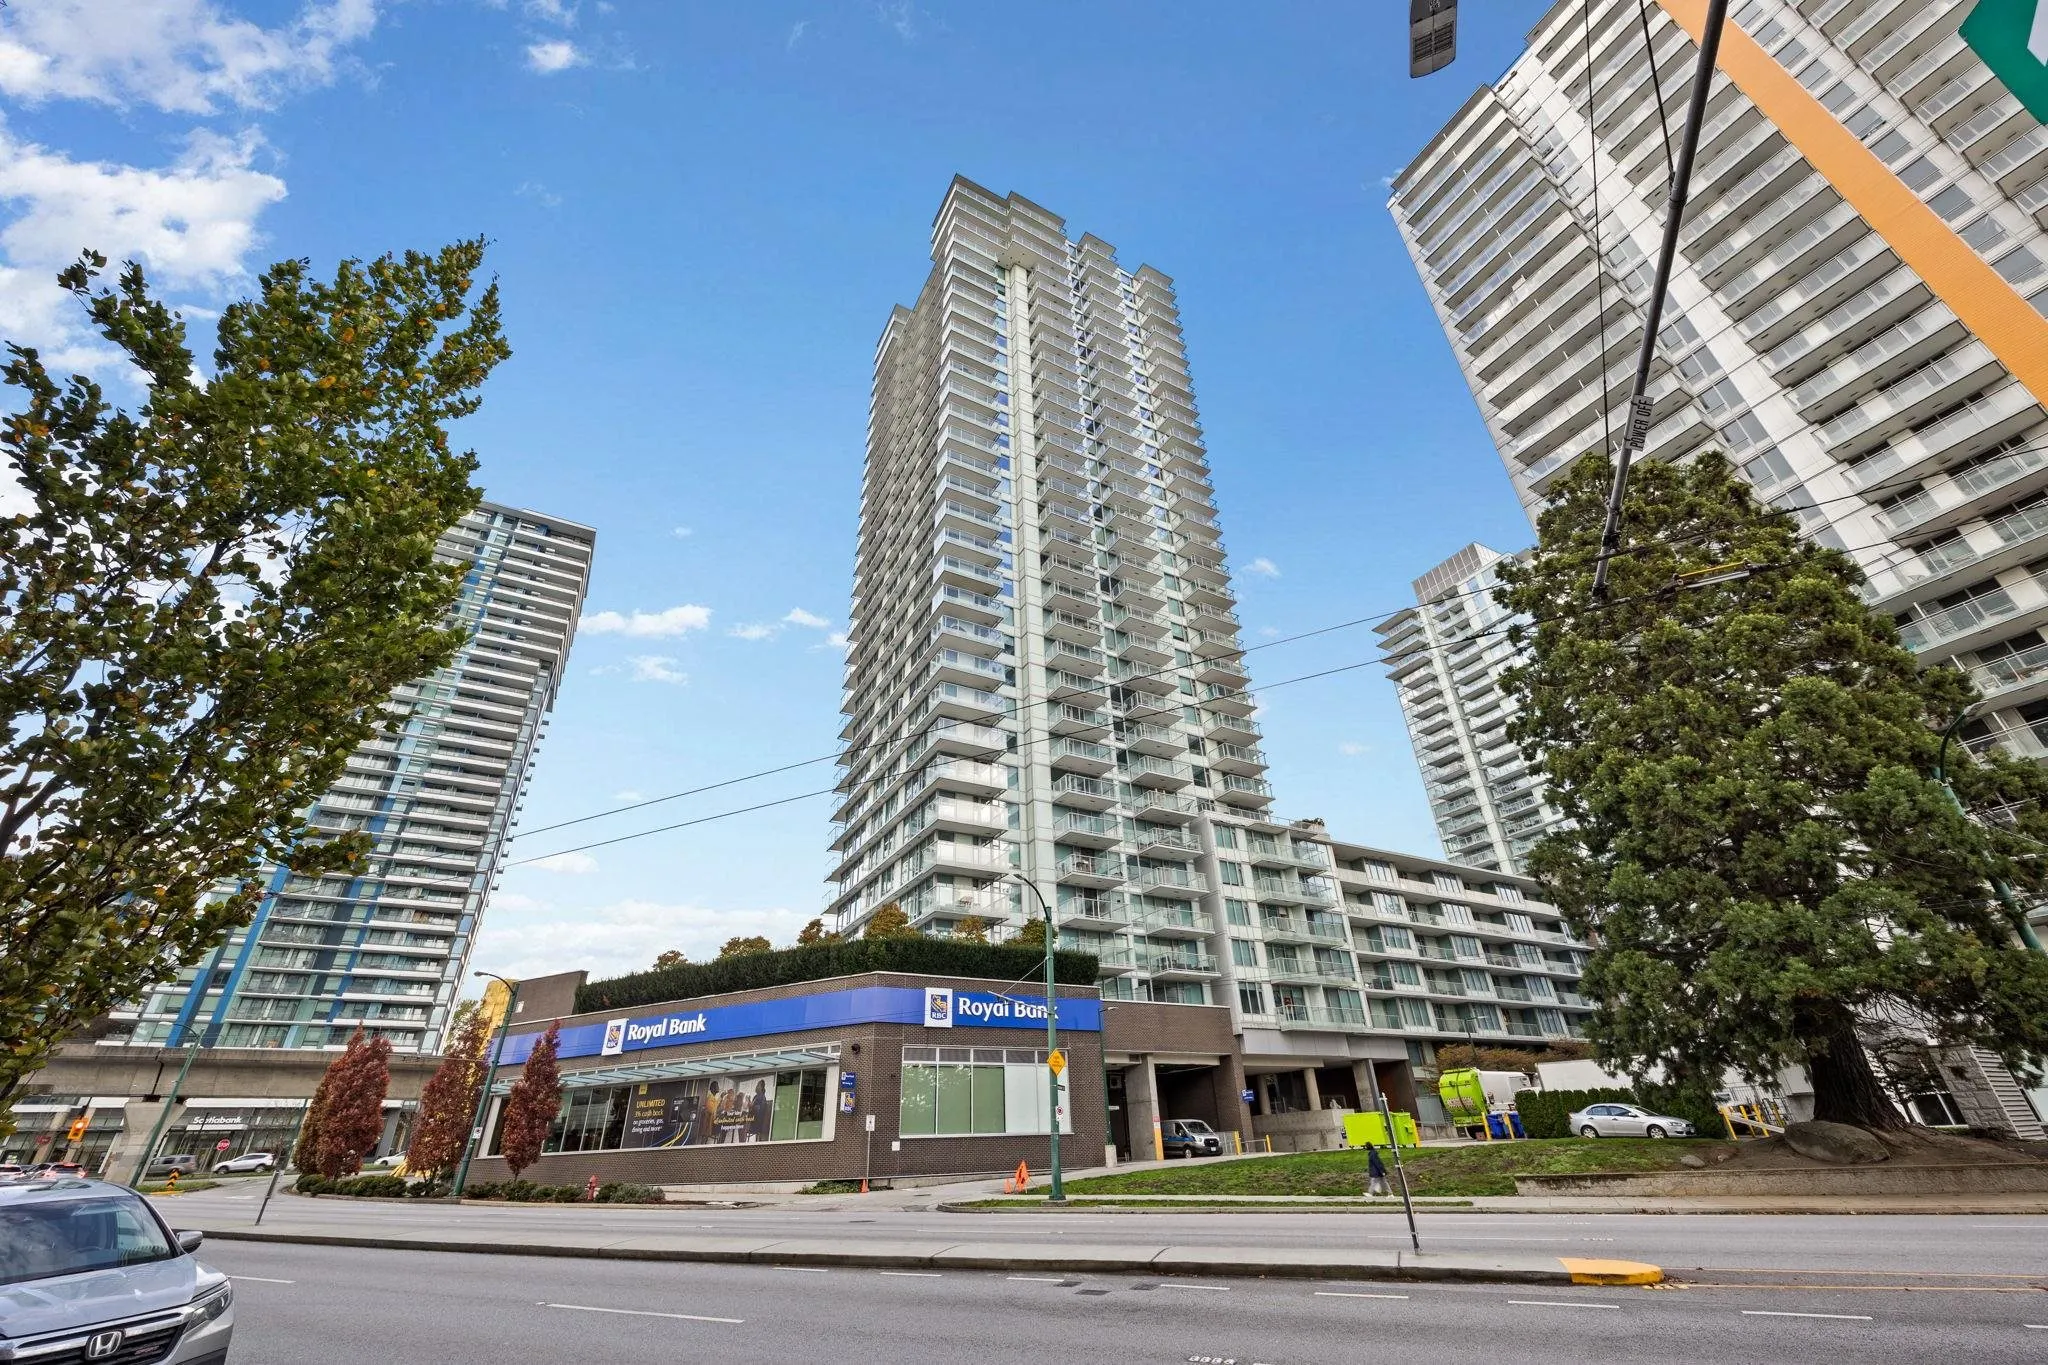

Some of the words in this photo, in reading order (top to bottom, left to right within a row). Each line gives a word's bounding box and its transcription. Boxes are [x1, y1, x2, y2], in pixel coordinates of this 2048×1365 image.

[1637, 399, 1653, 417] OFF
[1630, 419, 1649, 449] POWER
[958, 997, 1009, 1022] Royal
[627, 1018, 668, 1044] Royal
[669, 1013, 707, 1036] Bank
[636, 1099, 666, 1109] UNLIMITED
